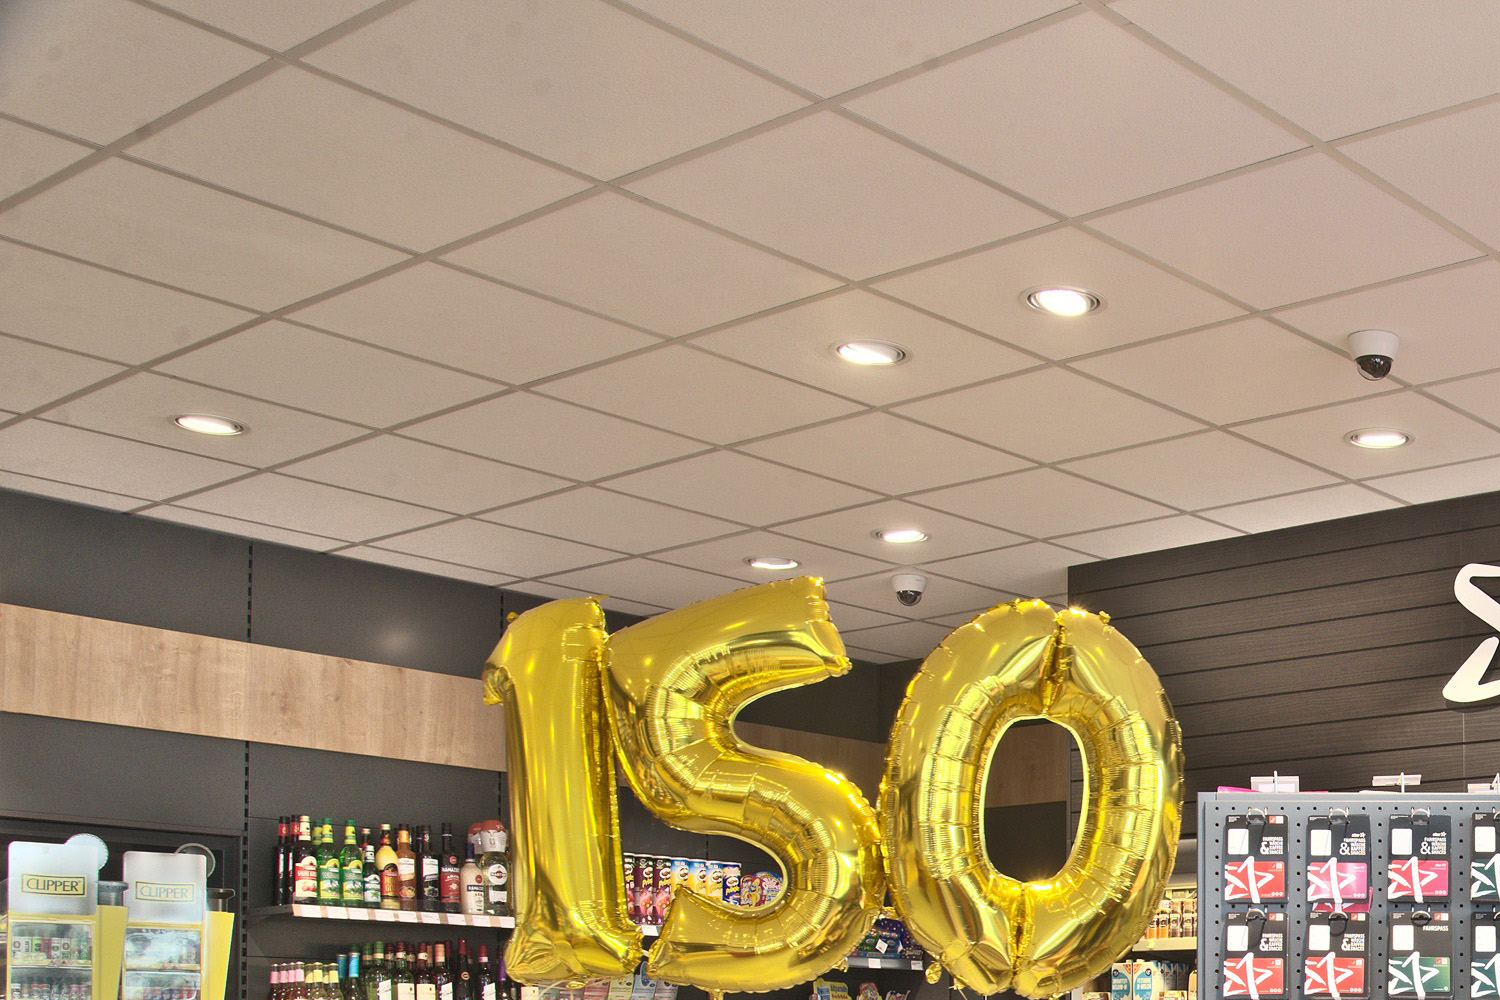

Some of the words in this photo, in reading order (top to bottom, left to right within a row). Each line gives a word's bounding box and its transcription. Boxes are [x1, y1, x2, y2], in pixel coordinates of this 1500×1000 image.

[1339, 842, 1350, 856] &
[1420, 841, 1432, 855] &
[26, 877, 80, 892] CLIPPER
[140, 886, 190, 899] CLIPPER
